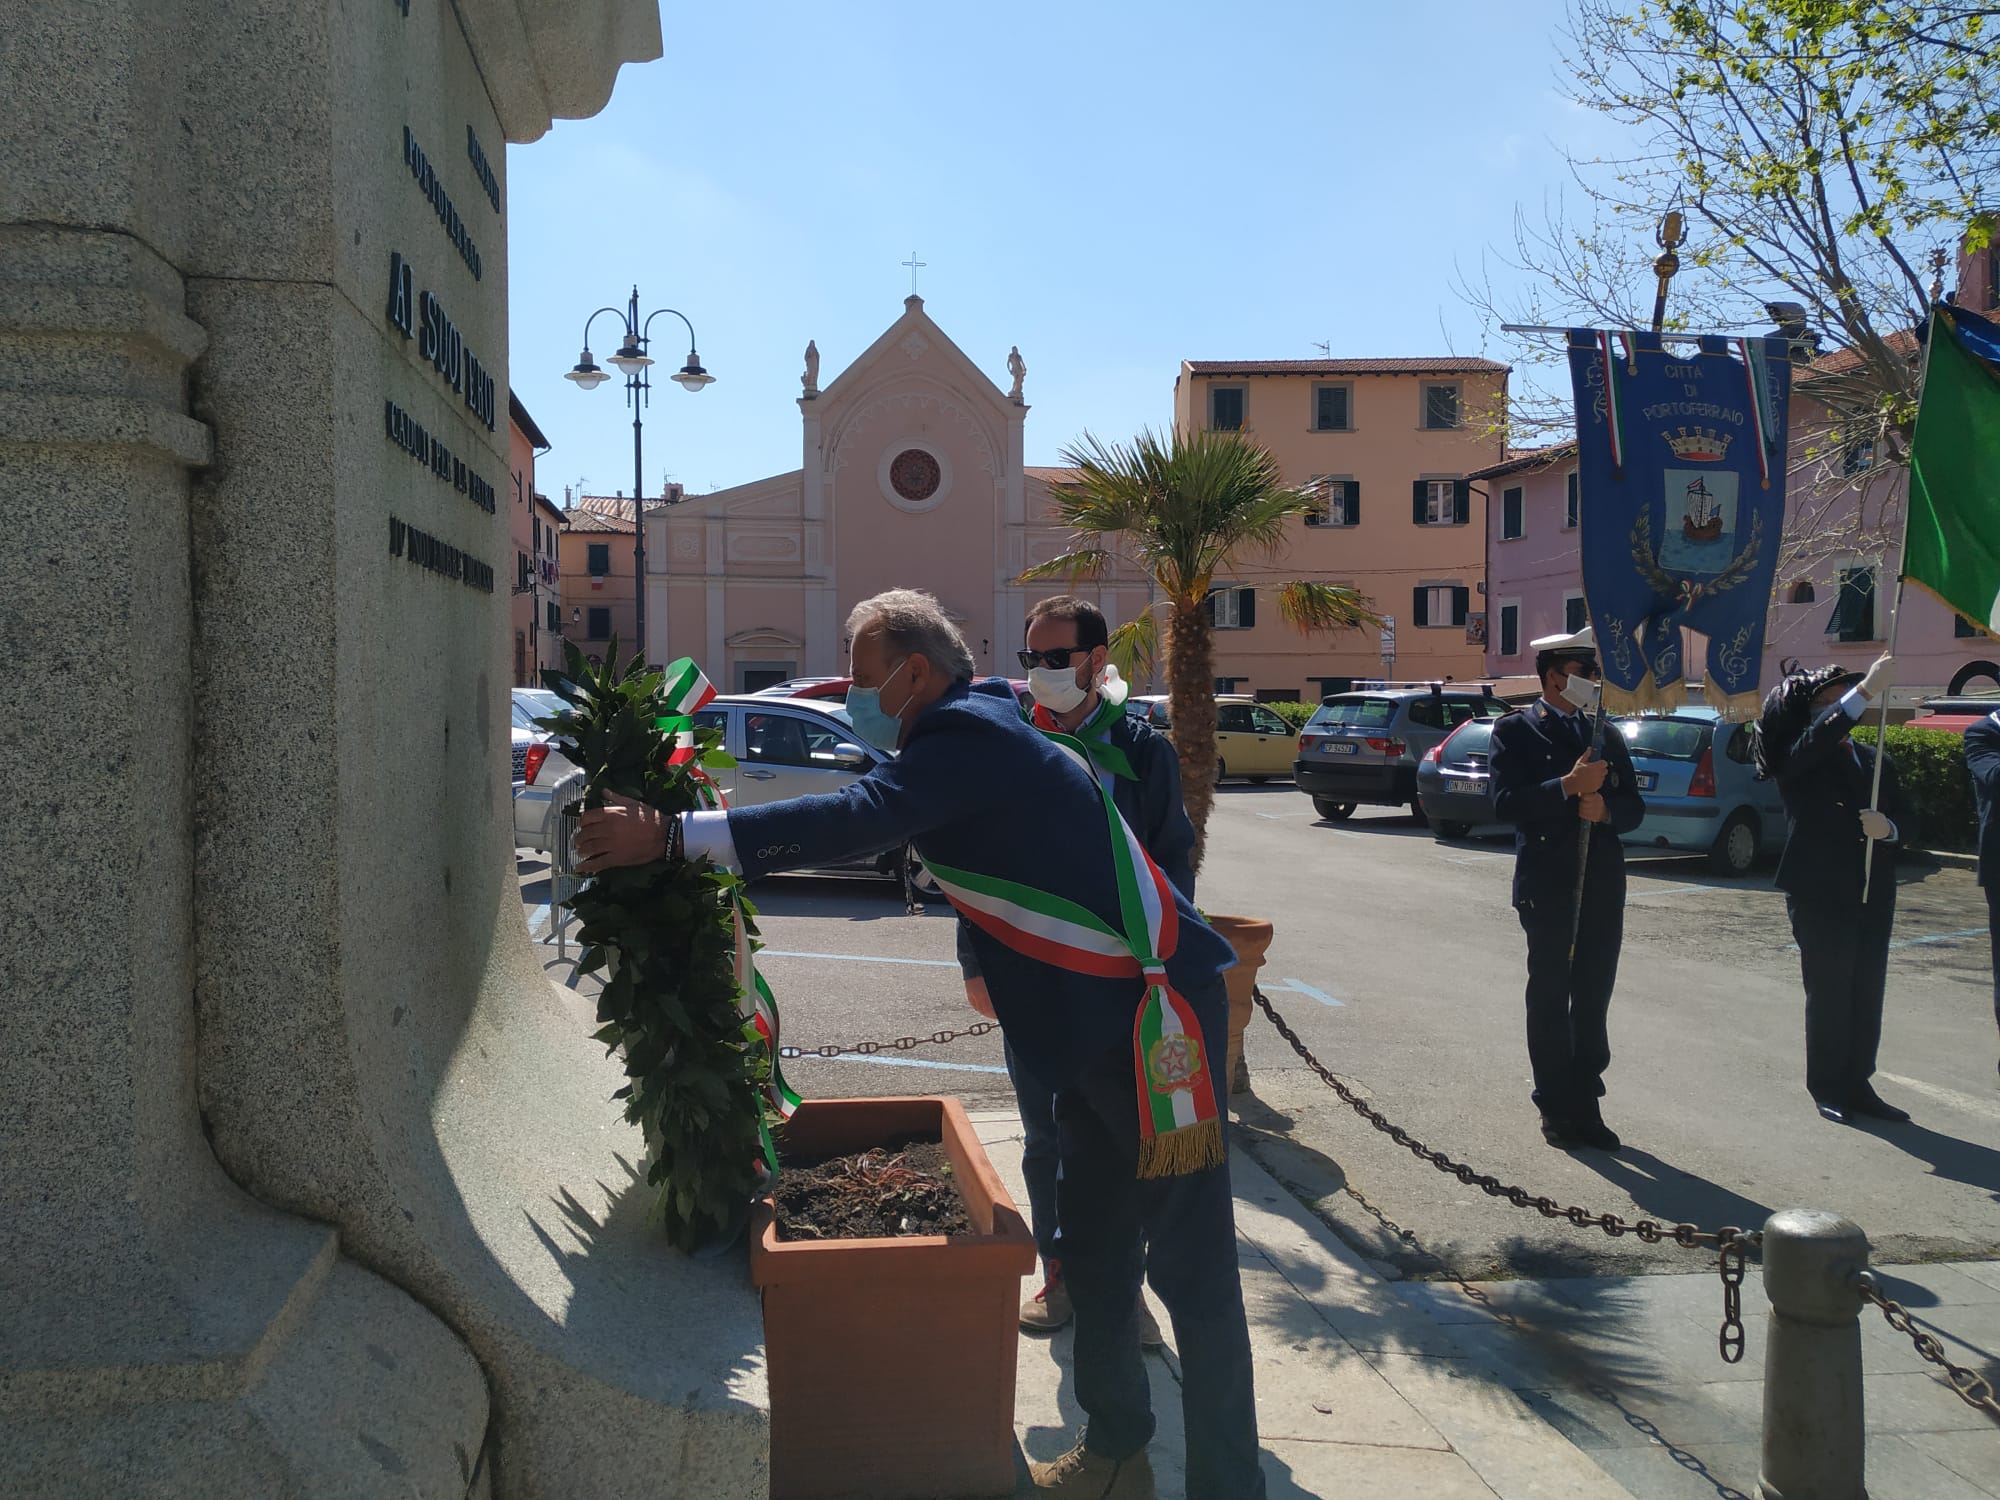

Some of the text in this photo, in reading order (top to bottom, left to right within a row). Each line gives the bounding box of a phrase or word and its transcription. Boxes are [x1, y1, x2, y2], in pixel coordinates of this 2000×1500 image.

[388, 252, 496, 432] AI SUOI EROI
[1684, 384, 1697, 397] DI
[1642, 402, 1744, 426] PORTOFERRAIO
